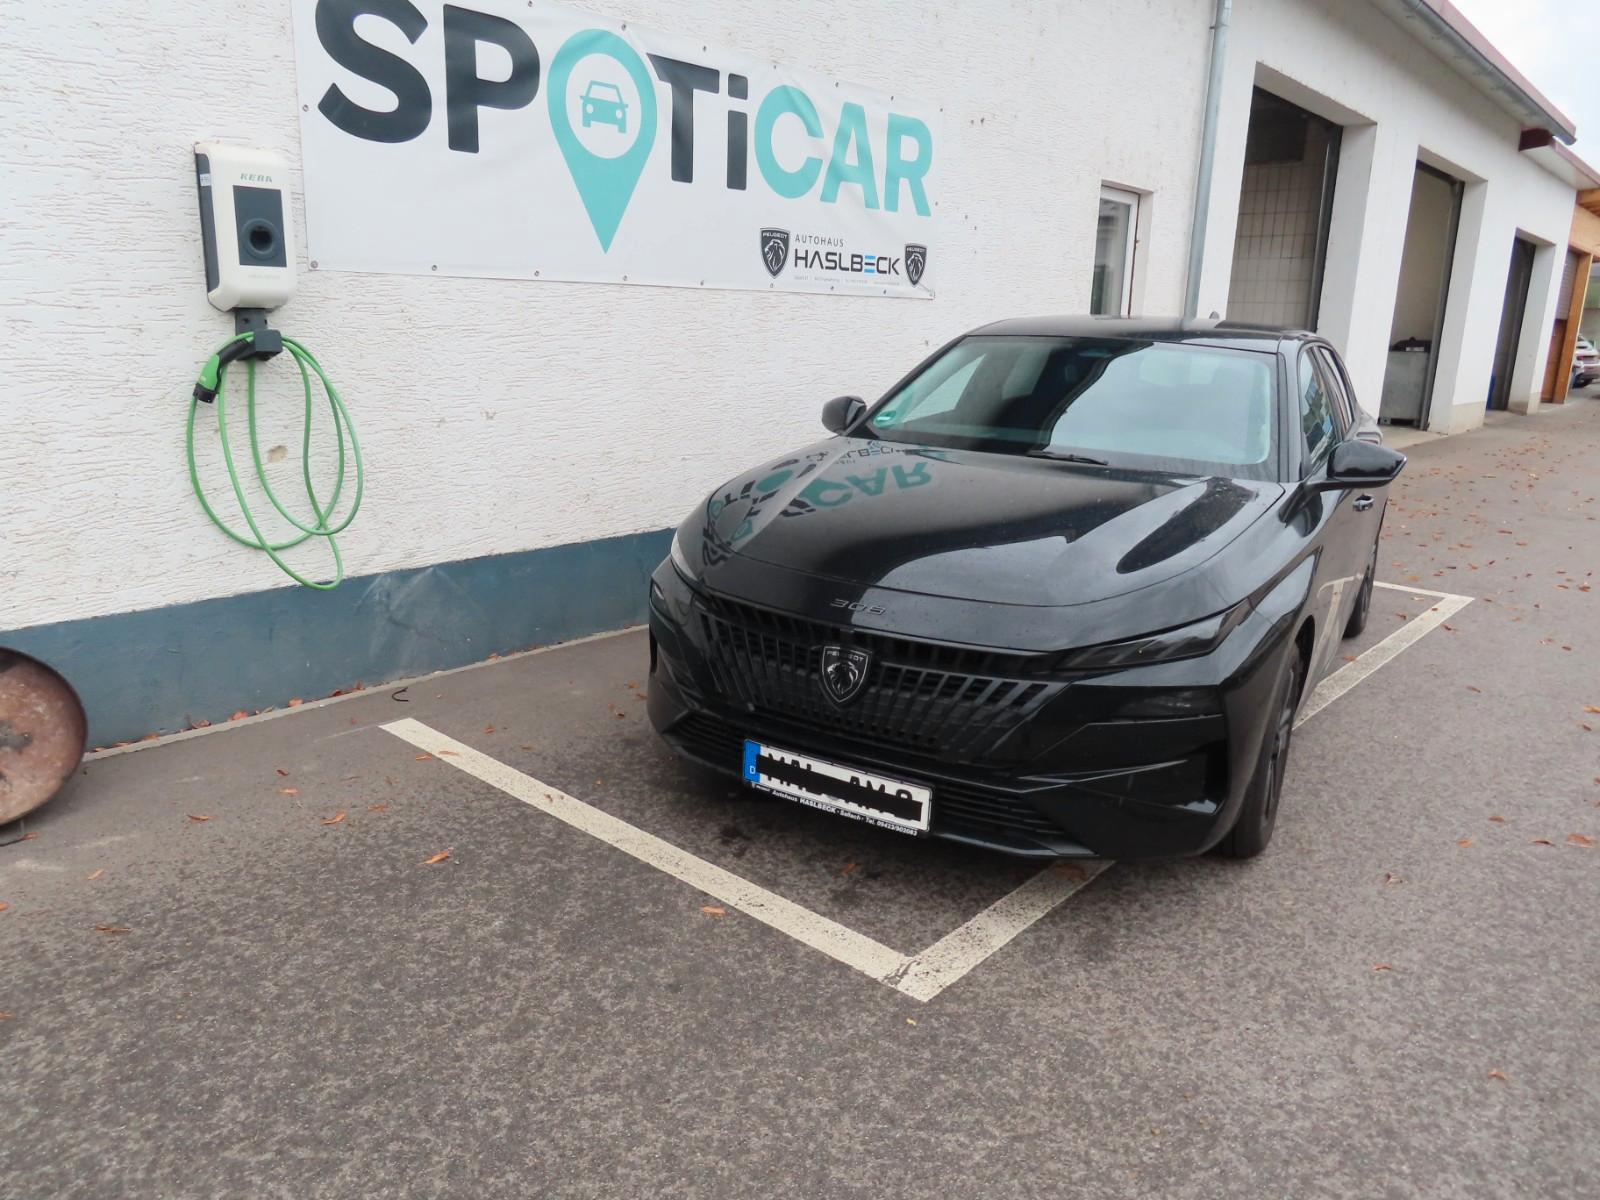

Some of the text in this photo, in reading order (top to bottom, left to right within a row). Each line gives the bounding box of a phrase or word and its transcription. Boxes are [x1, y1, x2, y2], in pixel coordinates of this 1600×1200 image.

[240, 172, 273, 183] KEBA
[795, 234, 844, 247] AUTOHAUS
[794, 248, 900, 275] HASLBECK
[830, 598, 886, 615] 308
[826, 650, 865, 662] PEEOT
[799, 797, 837, 814] HASLBECK
